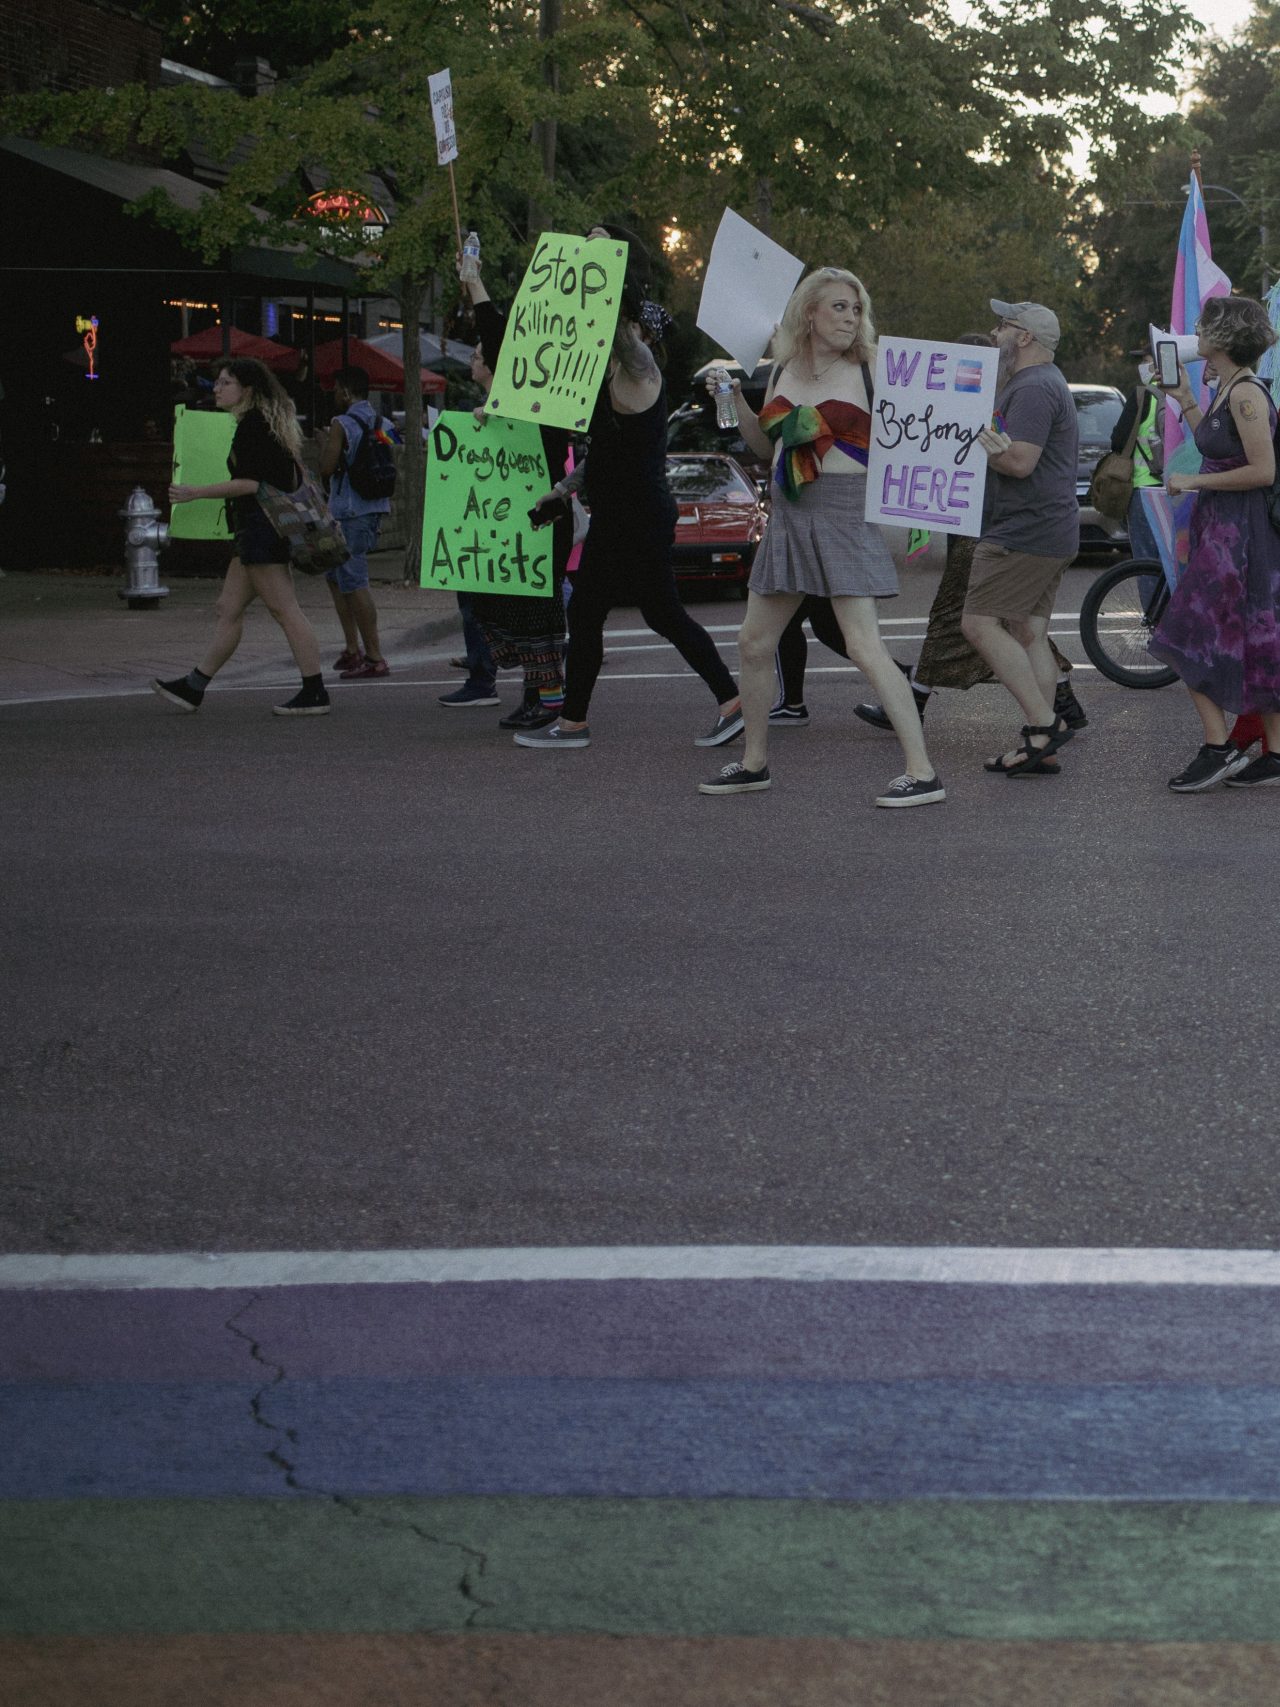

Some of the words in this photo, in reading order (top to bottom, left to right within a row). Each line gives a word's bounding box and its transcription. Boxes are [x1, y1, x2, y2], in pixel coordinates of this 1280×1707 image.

[530, 243, 607, 309] Stop
[513, 299, 577, 350] Killing
[886, 348, 948, 390] WE
[876, 399, 985, 465] Belong
[463, 486, 511, 521] Are
[882, 464, 975, 512] HERE
[431, 527, 547, 589] Artists
